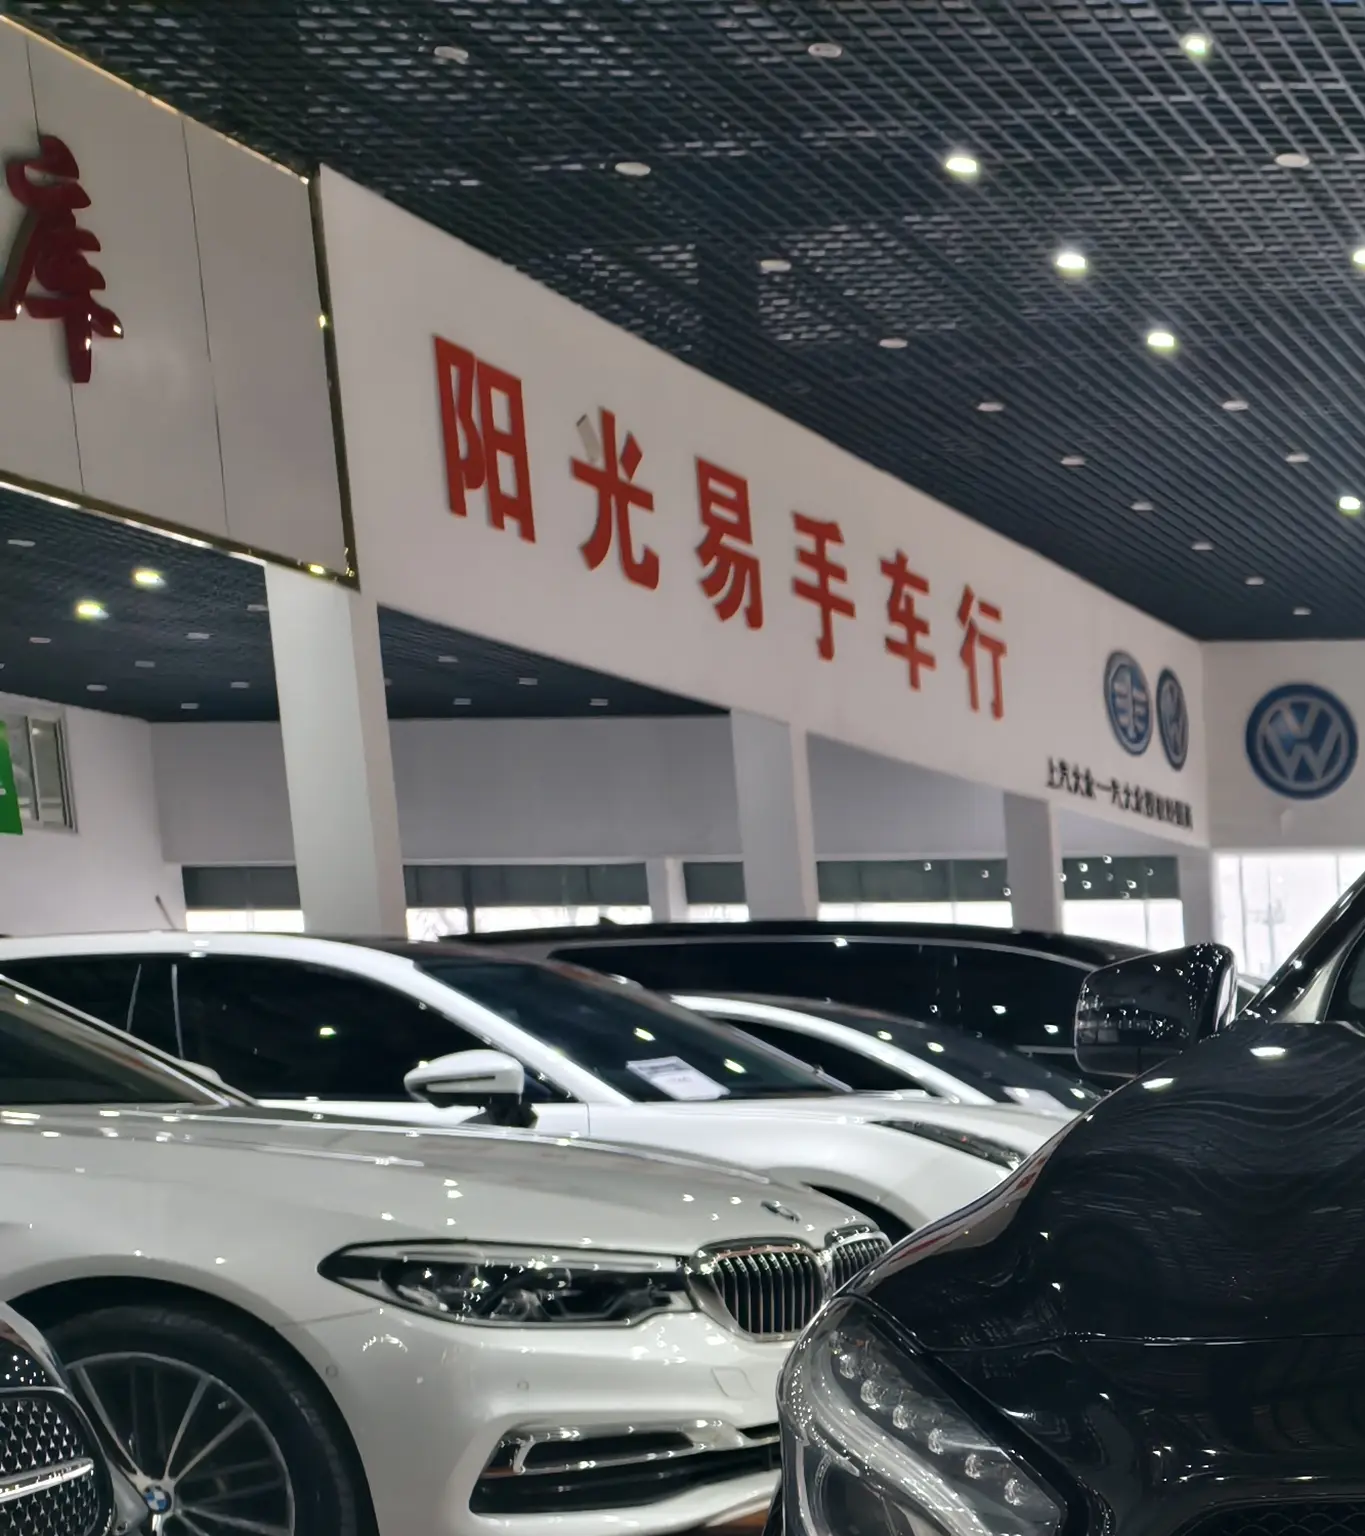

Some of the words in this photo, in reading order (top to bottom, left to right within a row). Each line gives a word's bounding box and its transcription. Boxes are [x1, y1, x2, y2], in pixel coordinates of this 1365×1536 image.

[433, 332, 1008, 722] 阳光易手车行
